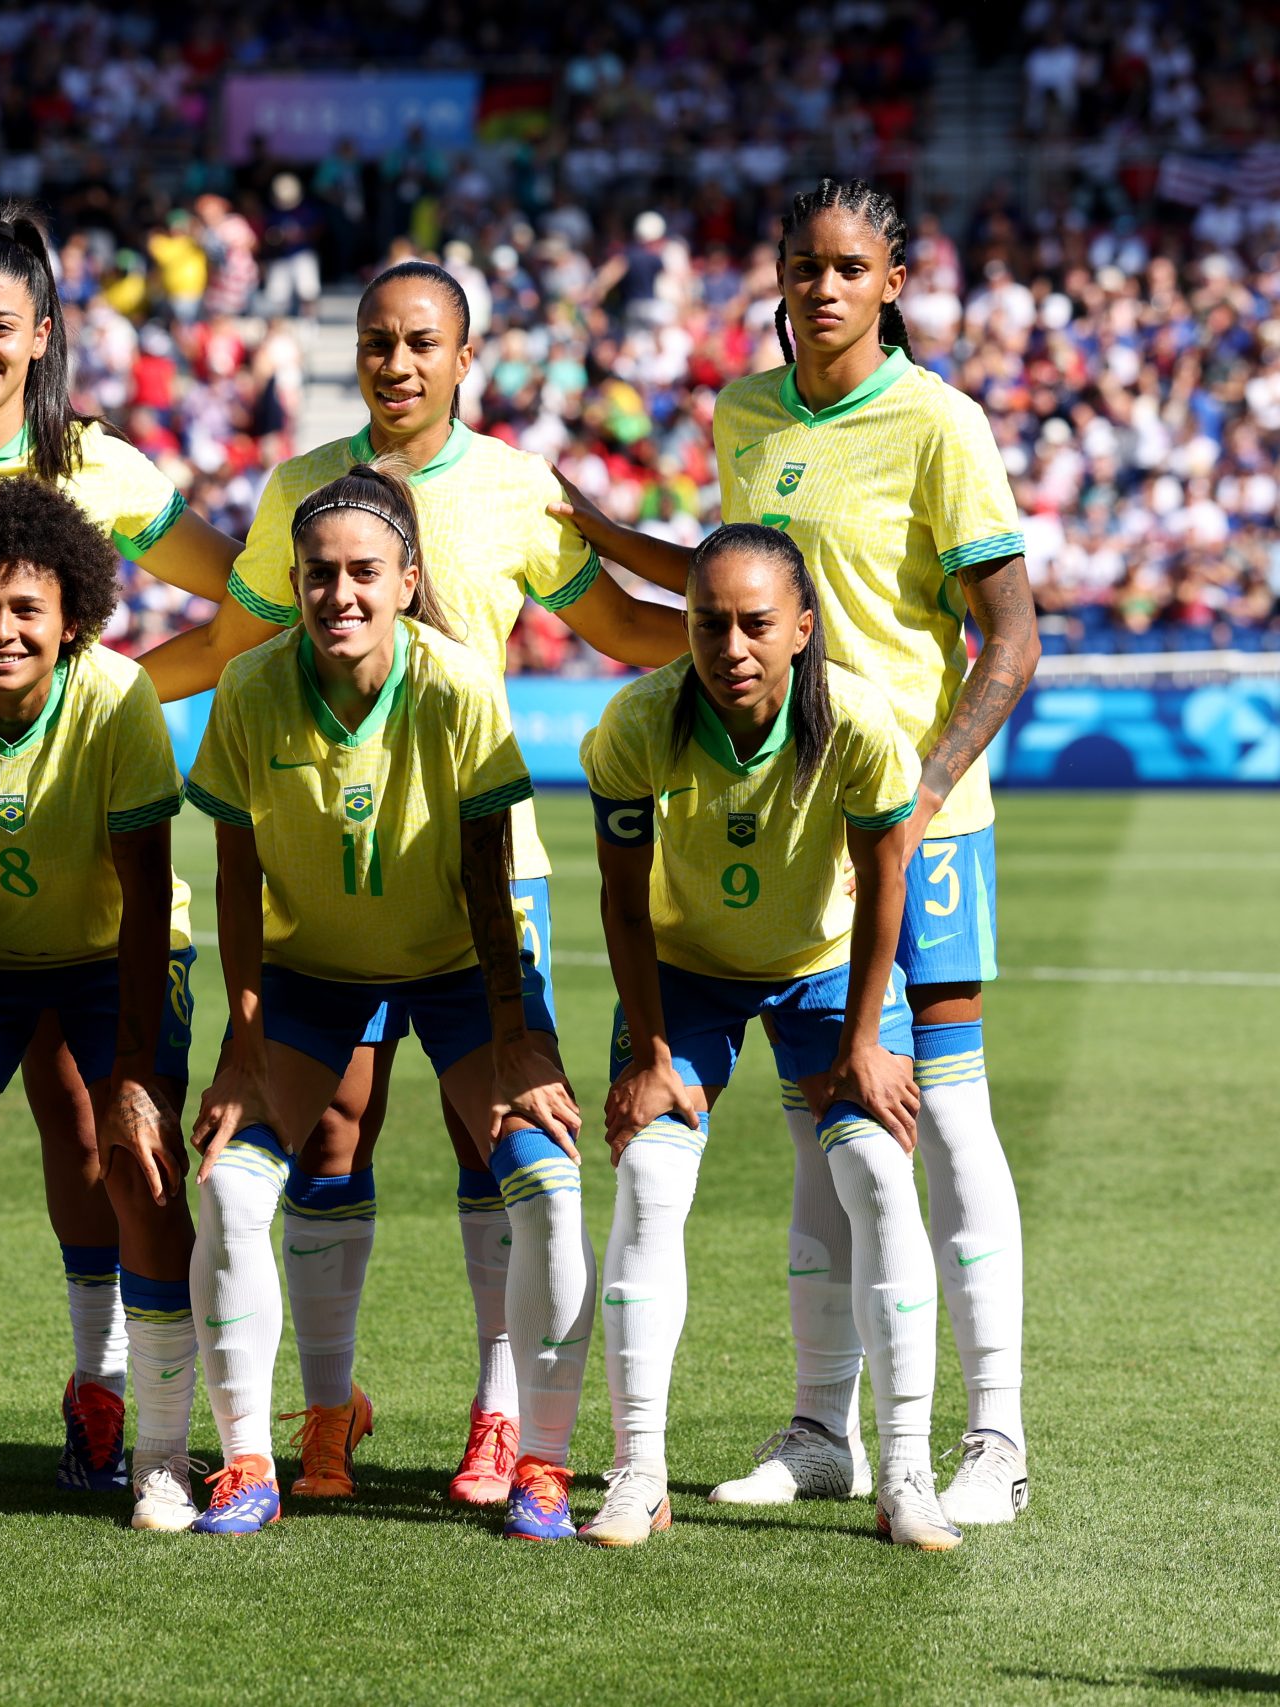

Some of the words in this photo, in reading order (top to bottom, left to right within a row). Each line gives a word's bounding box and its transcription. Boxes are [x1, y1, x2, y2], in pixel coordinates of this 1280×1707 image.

[784, 463, 805, 471] BRASIL
[344, 785, 371, 796] BRASIL
[607, 808, 644, 839] C
[0, 847, 38, 897] 8
[342, 829, 383, 897] 11
[721, 863, 760, 909] 9
[923, 842, 960, 917] 3
[168, 960, 189, 1026] 8
